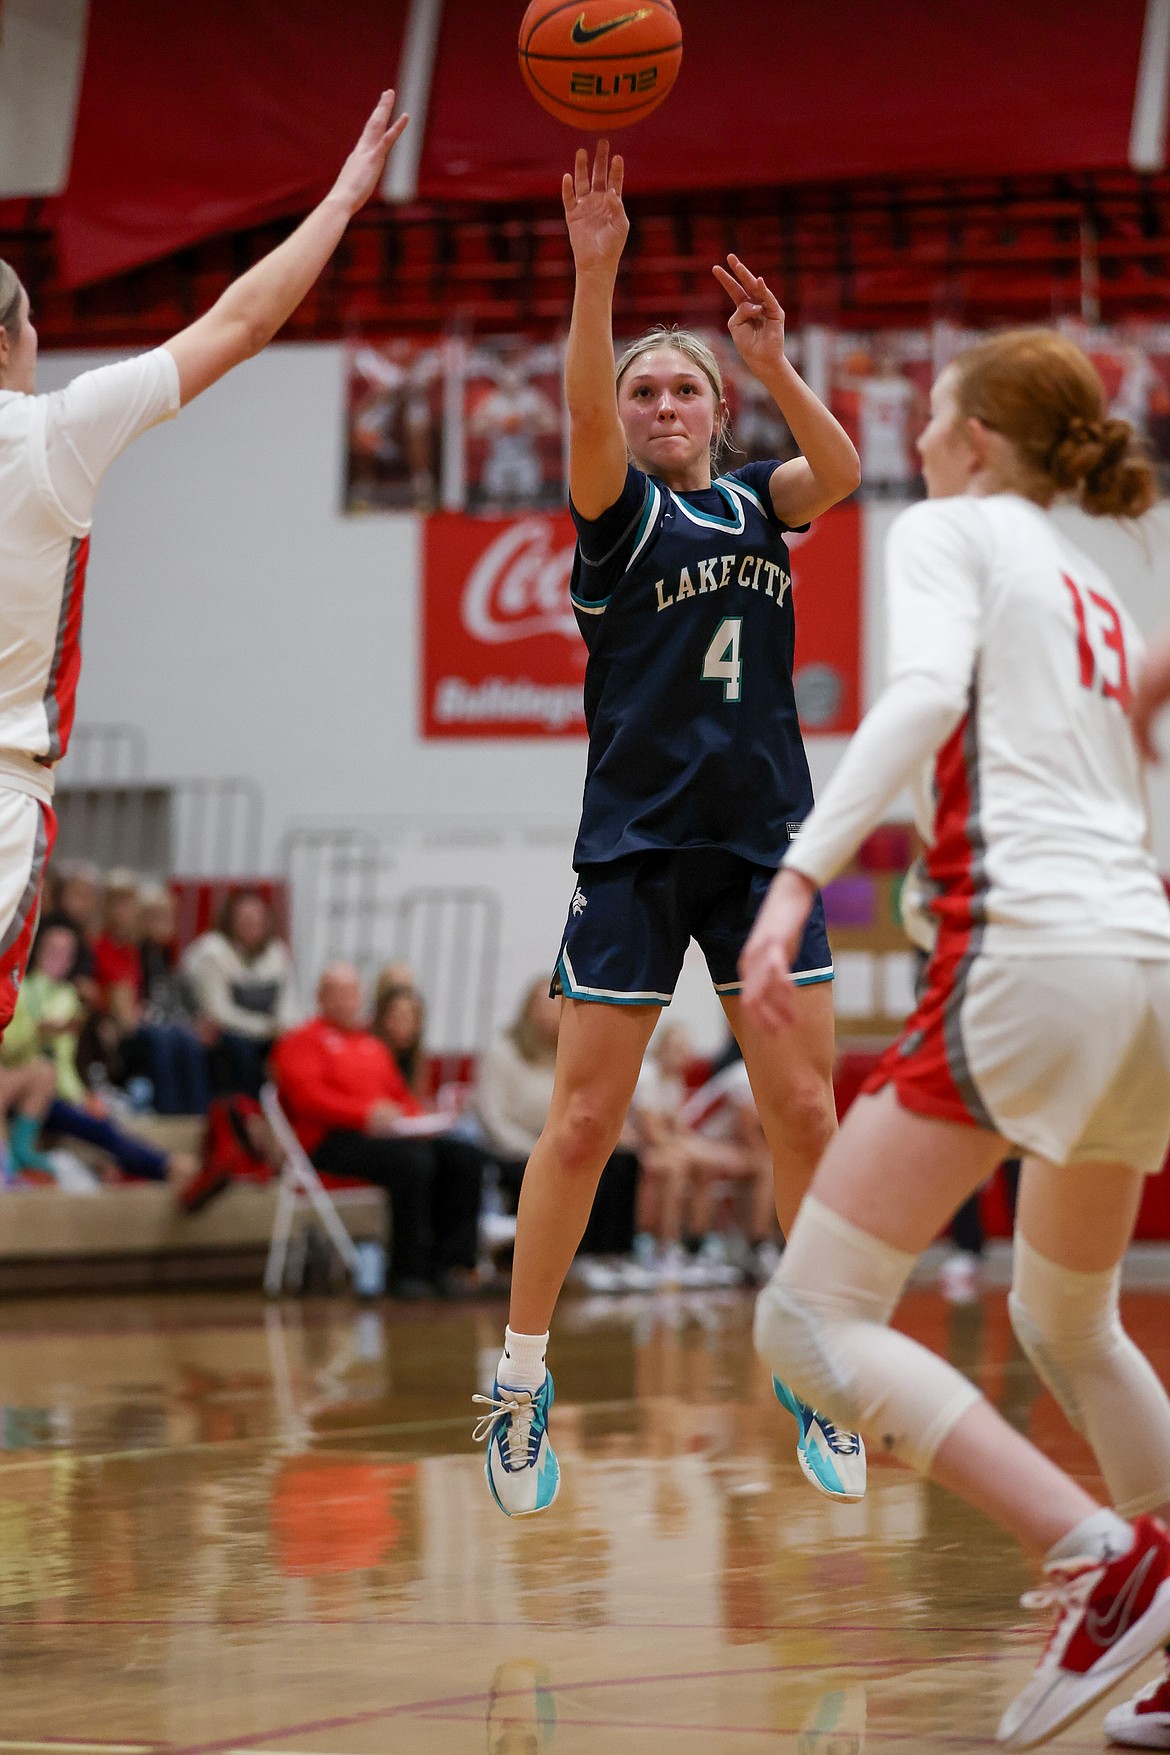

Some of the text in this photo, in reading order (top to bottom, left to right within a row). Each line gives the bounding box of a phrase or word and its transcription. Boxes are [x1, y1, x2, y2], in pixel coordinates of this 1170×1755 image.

[570, 66, 658, 96] ELITE
[655, 555, 791, 612] LAKE CITY
[701, 616, 743, 703] 4
[1060, 571, 1133, 713] 13
